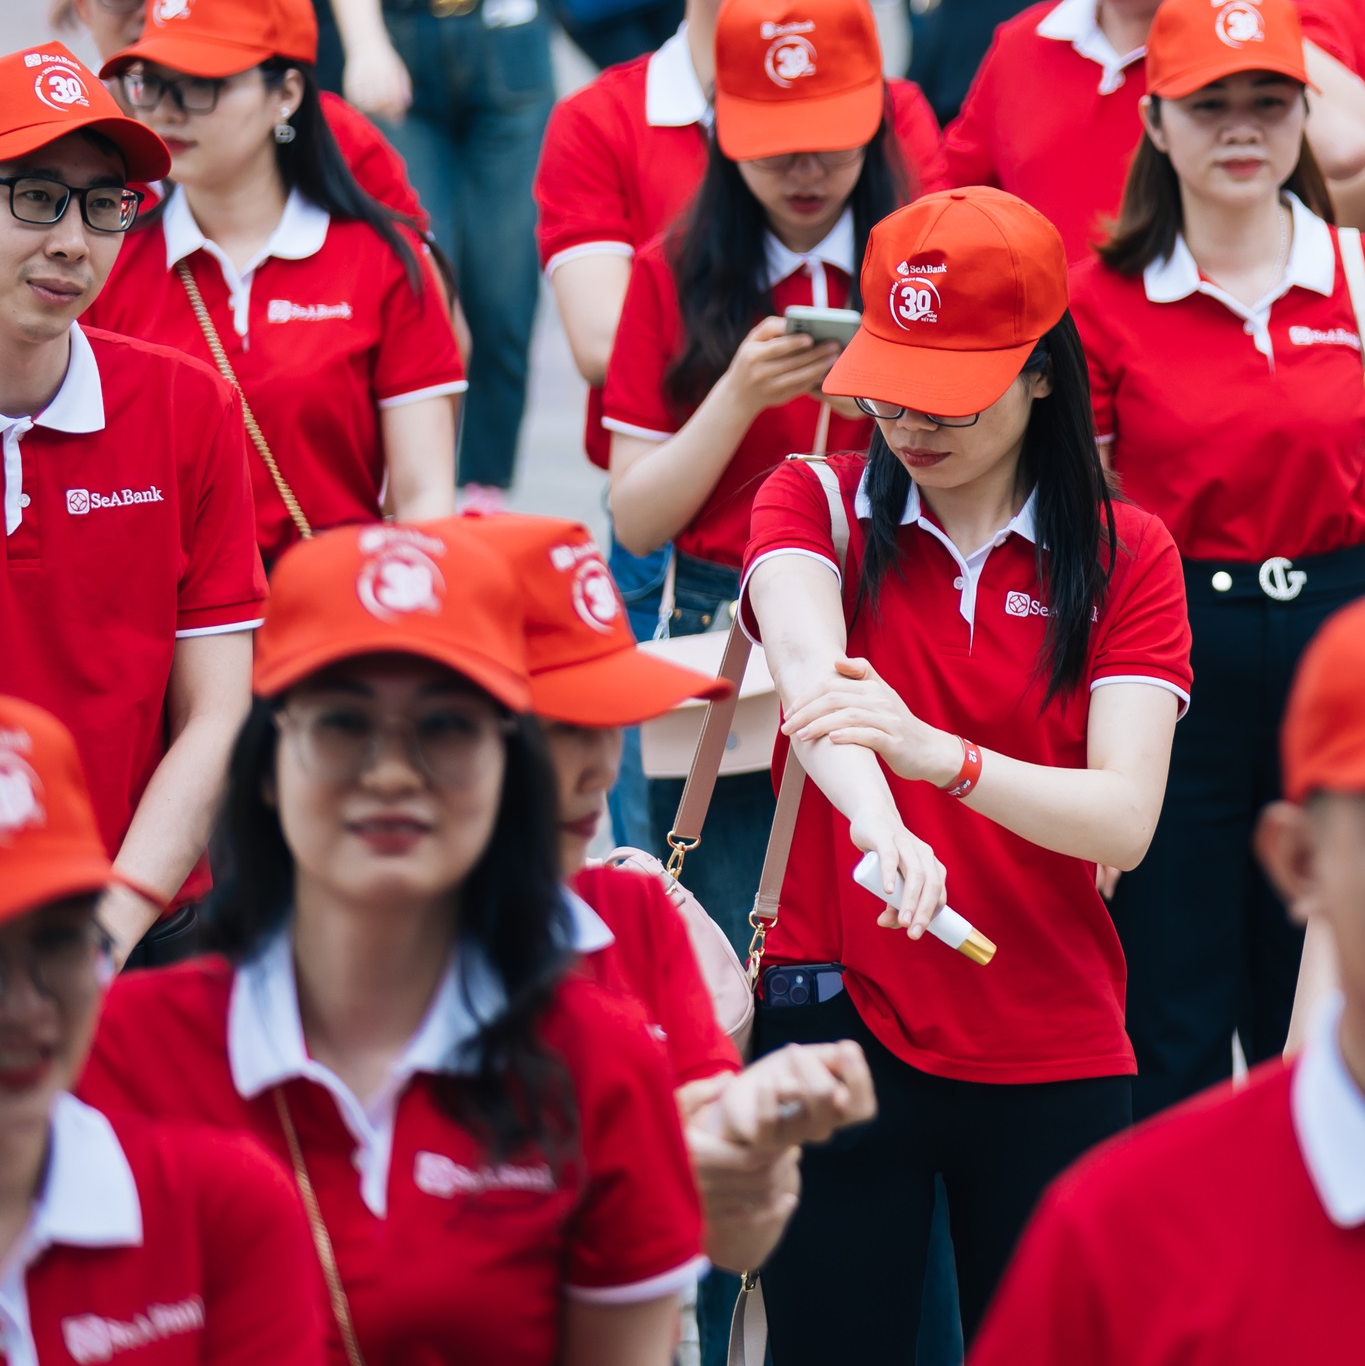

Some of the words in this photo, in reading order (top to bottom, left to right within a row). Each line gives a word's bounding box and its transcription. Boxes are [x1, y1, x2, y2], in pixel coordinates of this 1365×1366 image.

[48, 76, 82, 104] 30
[909, 263, 947, 274] SeABank
[899, 286, 934, 321] 30
[90, 486, 164, 510] SeABank
[967, 748, 978, 764] 12
